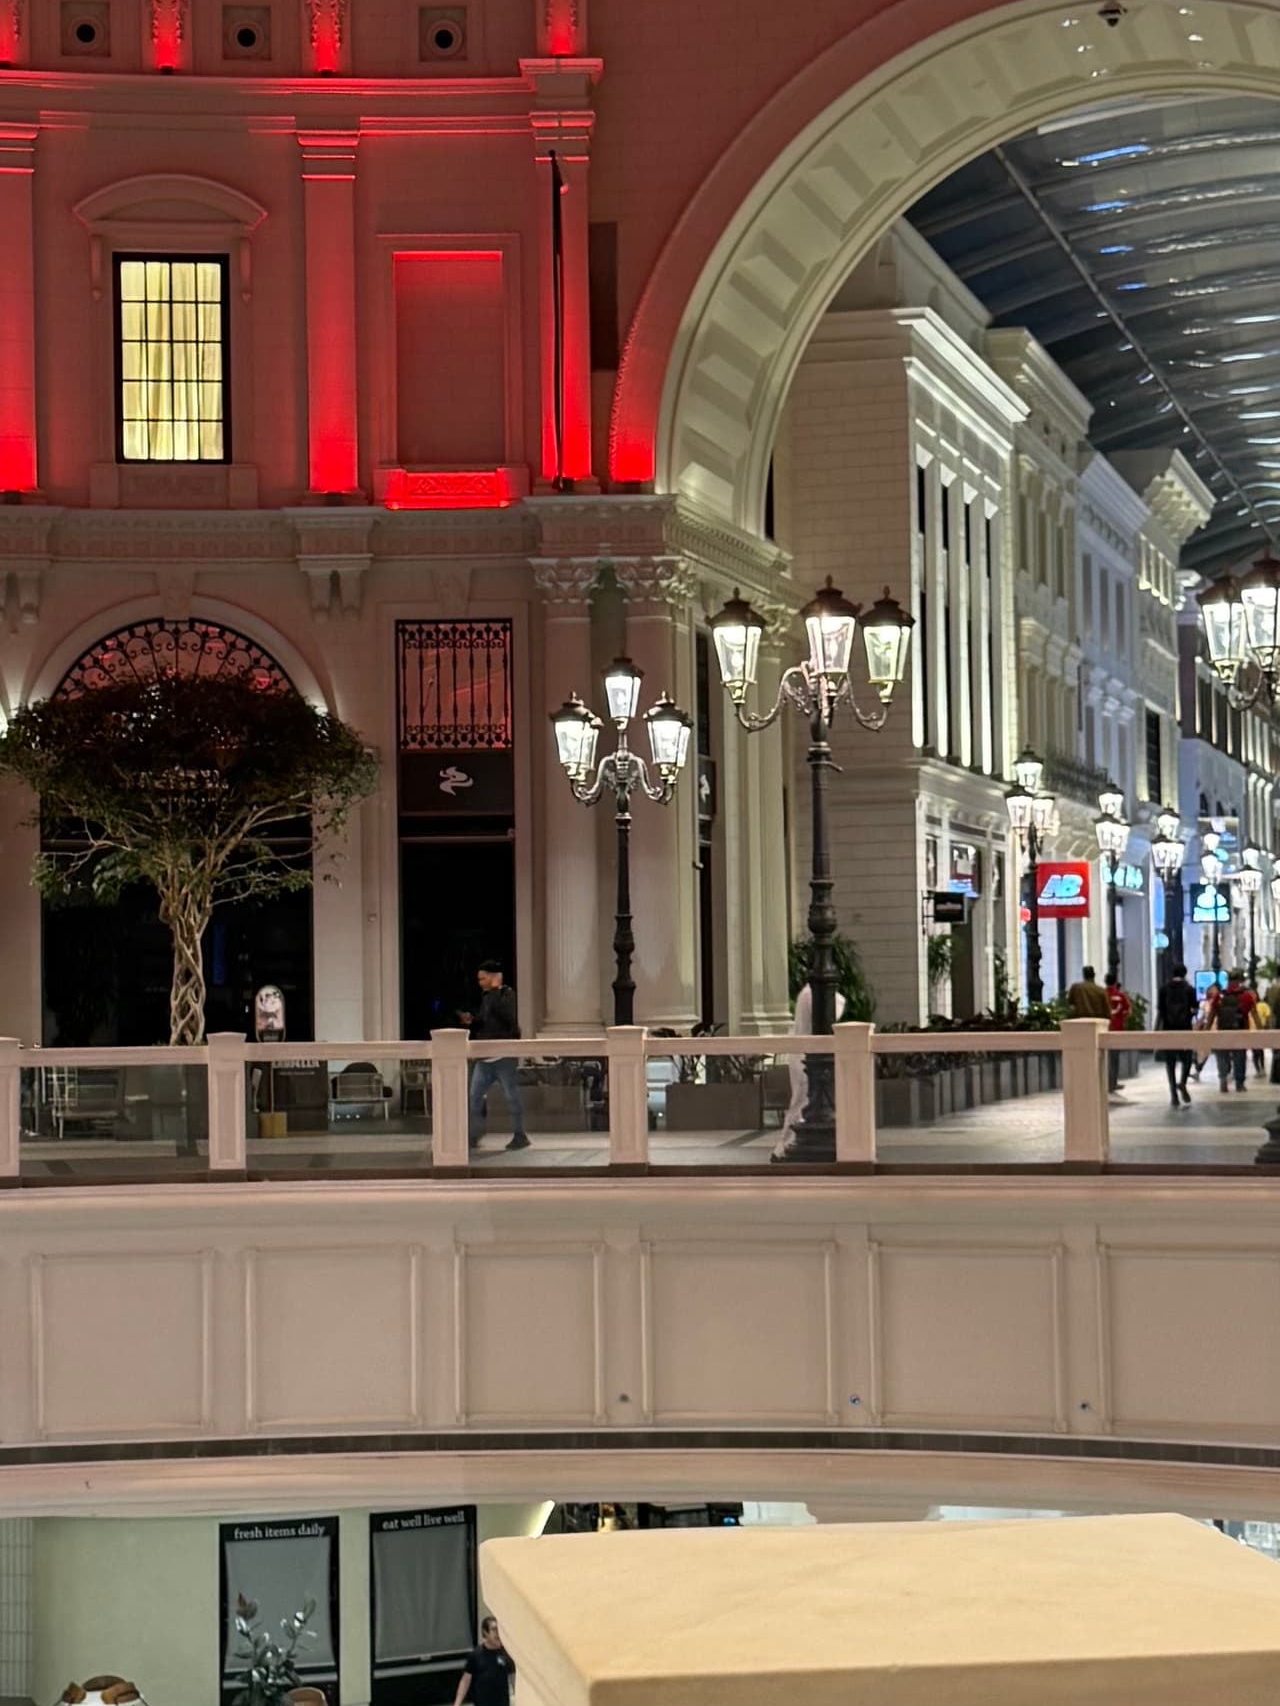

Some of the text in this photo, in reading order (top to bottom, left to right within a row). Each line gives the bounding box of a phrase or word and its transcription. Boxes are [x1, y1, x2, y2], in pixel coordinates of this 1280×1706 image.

[382, 1510, 466, 1530] eat well live well
[233, 1522, 326, 1540] fresh items daily
